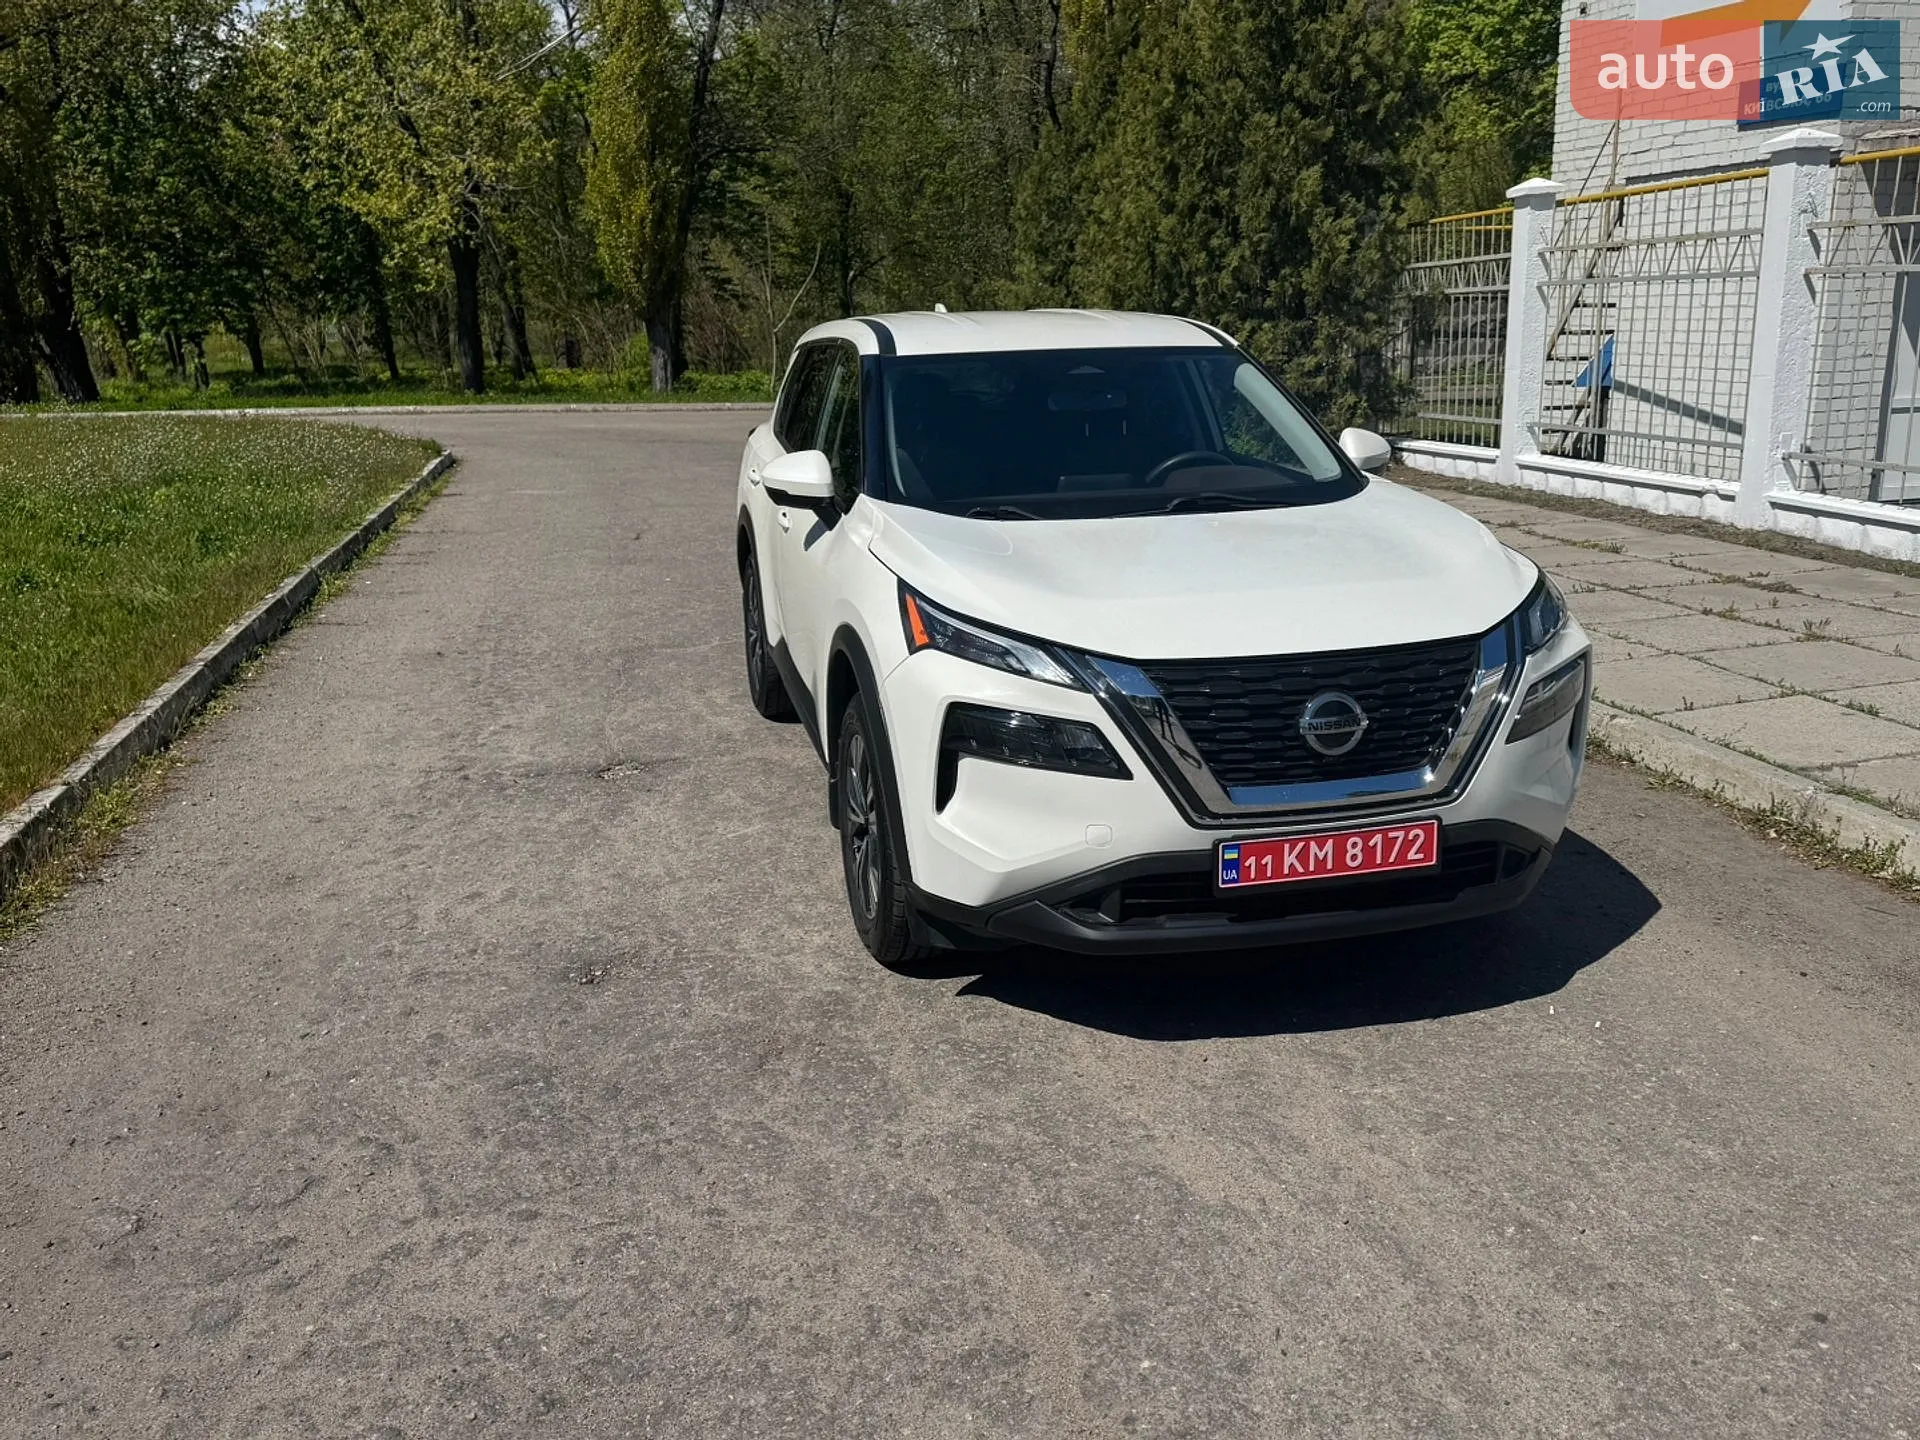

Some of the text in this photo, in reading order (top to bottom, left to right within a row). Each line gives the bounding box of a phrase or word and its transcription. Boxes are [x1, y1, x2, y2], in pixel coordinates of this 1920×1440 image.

[1307, 719, 1362, 732] NISSAN
[1244, 829, 1425, 880] 11 KM 8172
[1223, 869, 1238, 881] UA
